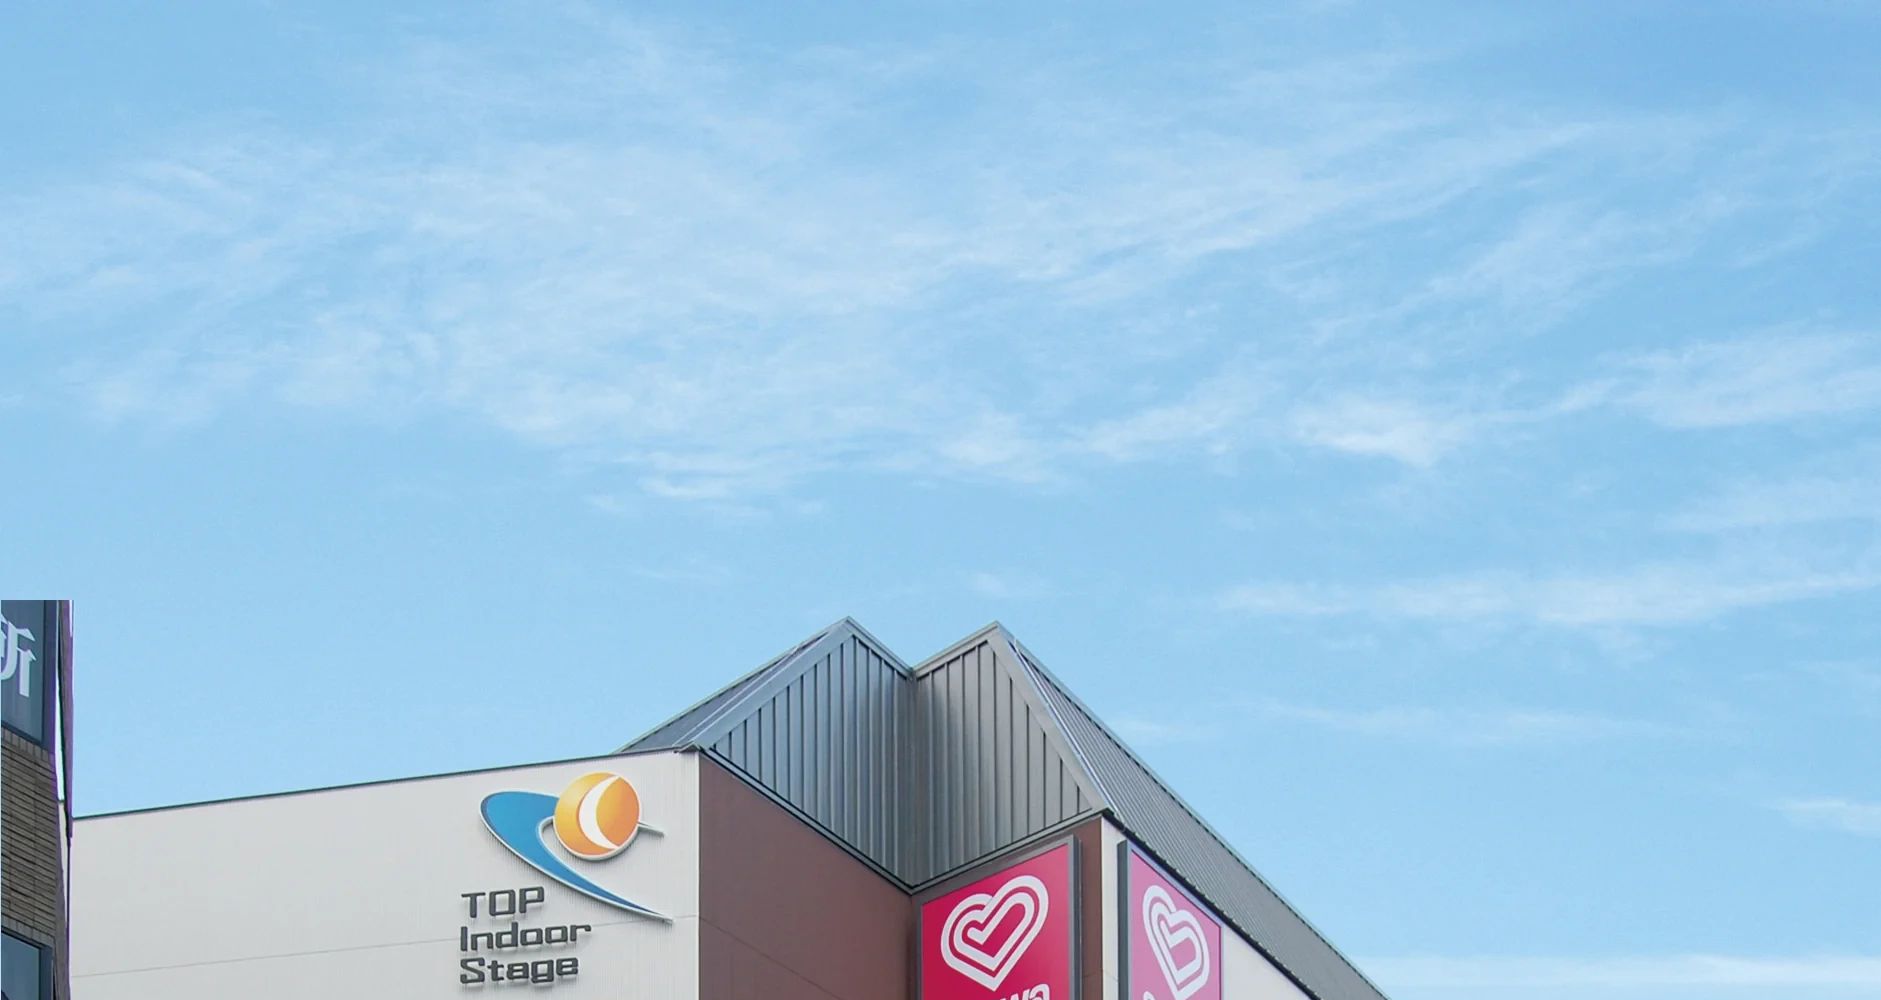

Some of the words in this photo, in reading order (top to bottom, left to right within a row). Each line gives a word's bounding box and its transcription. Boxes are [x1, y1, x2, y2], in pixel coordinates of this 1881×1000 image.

[461, 886, 545, 918] TOP
[461, 922, 592, 951] Indoor
[460, 957, 579, 984] Stage
